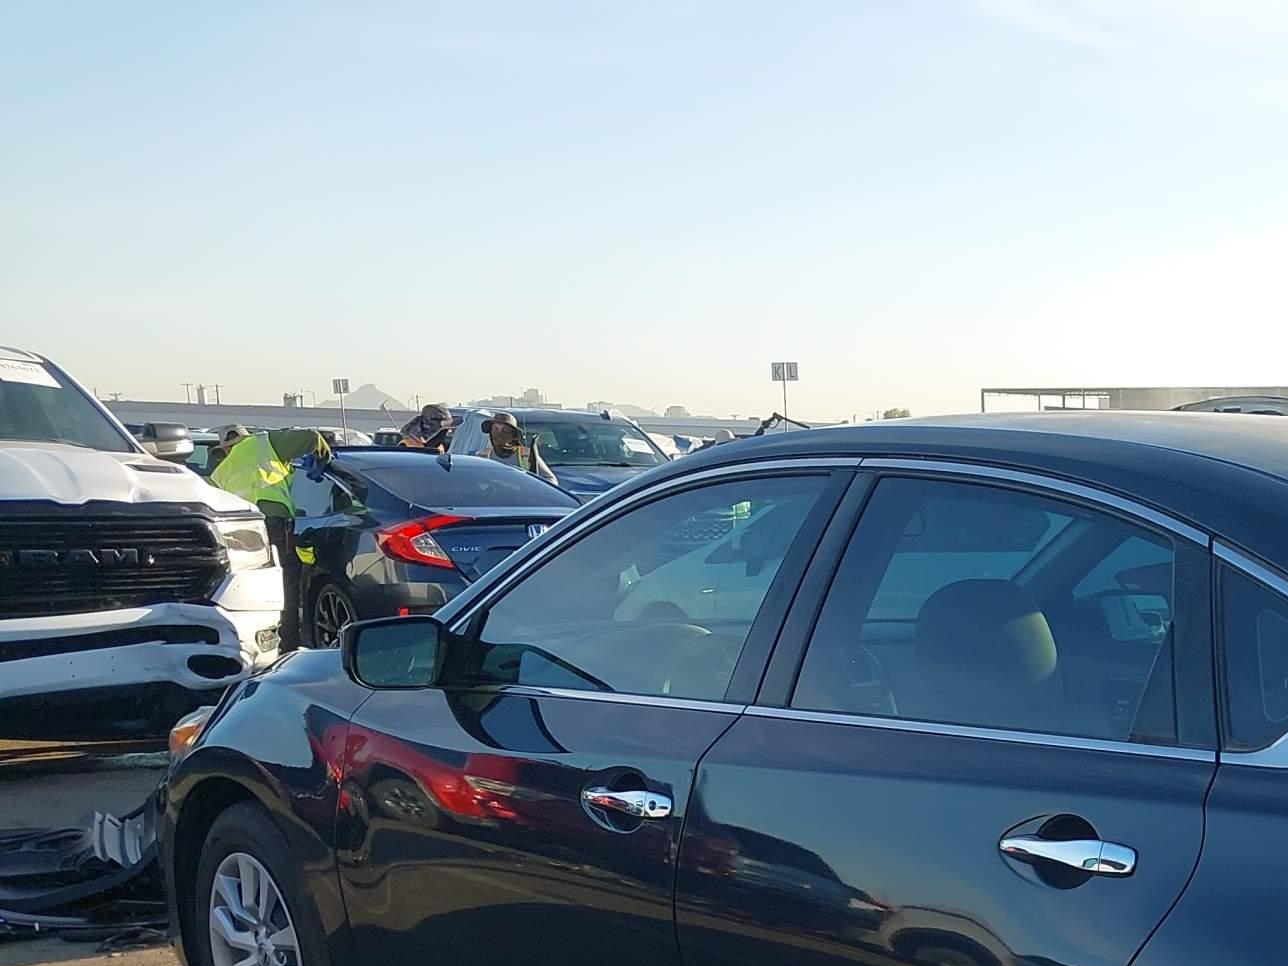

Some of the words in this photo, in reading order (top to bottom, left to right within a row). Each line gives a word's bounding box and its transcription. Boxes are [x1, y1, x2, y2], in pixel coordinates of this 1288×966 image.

[774, 365, 782, 378] K
[789, 365, 796, 378] L
[18, 548, 139, 565] RAM
